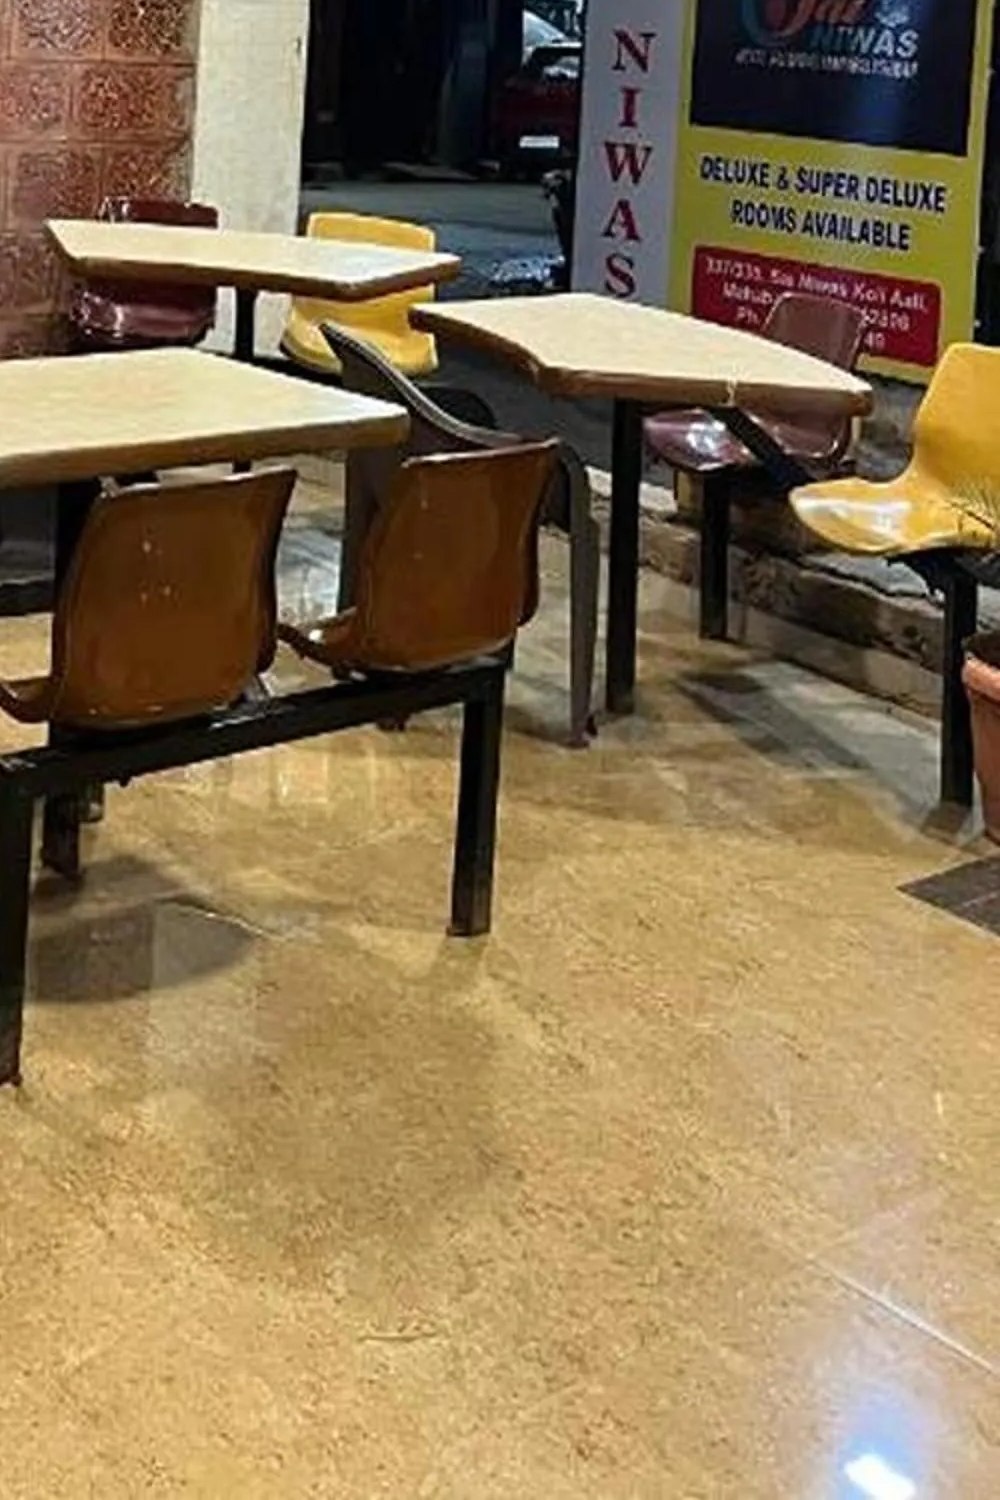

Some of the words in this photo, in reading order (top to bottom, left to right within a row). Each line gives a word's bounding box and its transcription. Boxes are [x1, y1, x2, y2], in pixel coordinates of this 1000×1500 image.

[601, 28, 656, 298] NIWAS
[700, 155, 770, 188] DELUXE
[776, 165, 789, 190] &
[794, 167, 859, 200] SUPER
[865, 176, 946, 213] DELUXE
[731, 199, 796, 233] ROOMS
[801, 210, 911, 251] AVAILABLE
